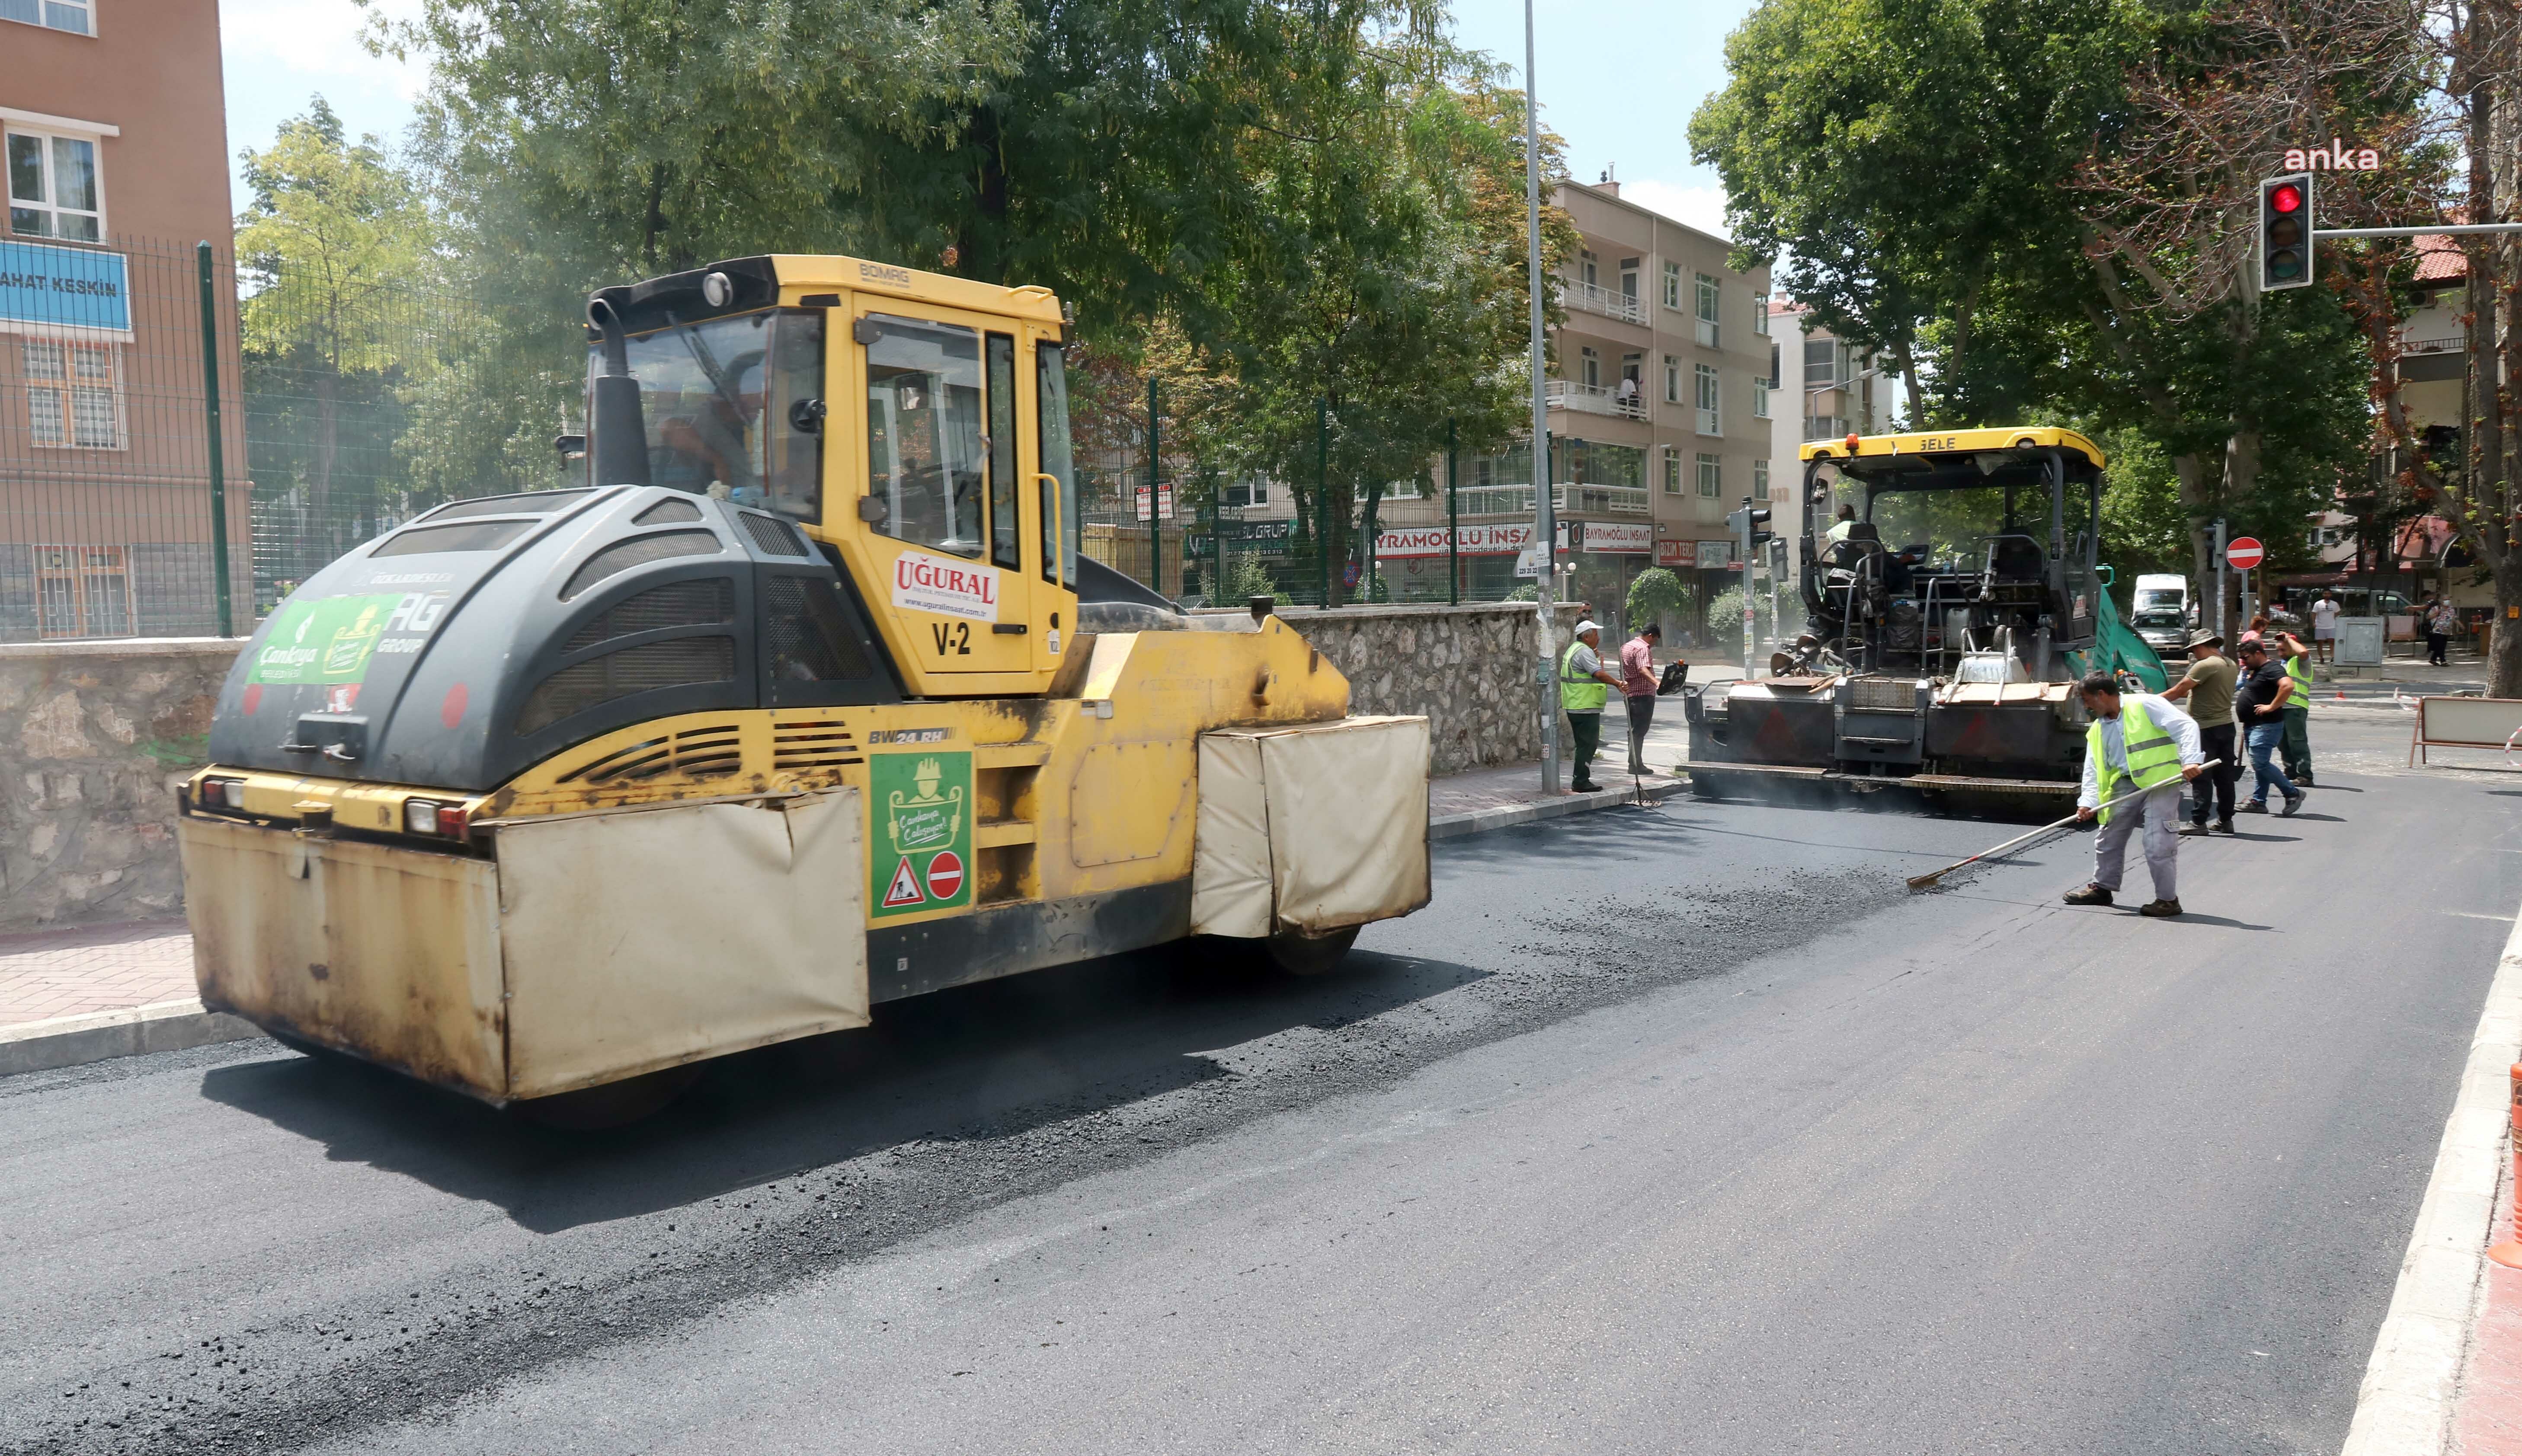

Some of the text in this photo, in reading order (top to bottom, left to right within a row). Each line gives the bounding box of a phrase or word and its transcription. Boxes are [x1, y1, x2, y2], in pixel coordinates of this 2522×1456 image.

[859, 263, 909, 283] BOMAG
[52, 277, 116, 297] KESKİN
[1585, 525, 1650, 542] BAYRAMOĞLU İNŞAAT
[1660, 541, 1677, 556] BİZİM
[897, 556, 996, 604] UĞURAL
[377, 639, 425, 653] GROUP
[932, 622, 970, 655] V-2
[899, 809, 940, 830] Çankaya
